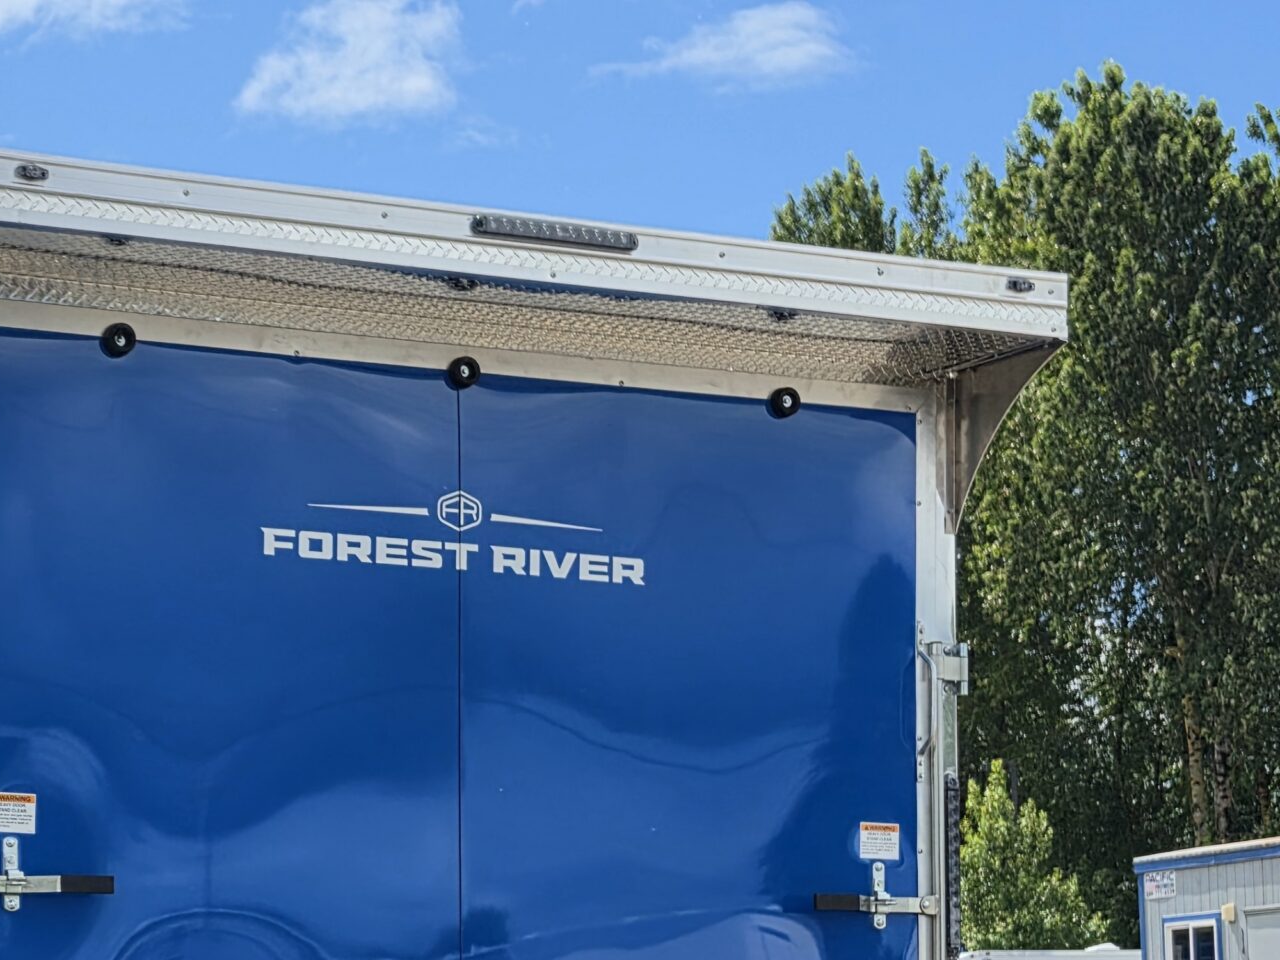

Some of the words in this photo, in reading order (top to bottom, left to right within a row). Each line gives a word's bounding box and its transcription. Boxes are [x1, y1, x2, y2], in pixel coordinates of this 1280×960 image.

[260, 527, 479, 570] FOREST
[489, 545, 645, 585] RIVER
[0, 794, 32, 803] WARNING
[1146, 870, 1175, 882] PACIFIC
